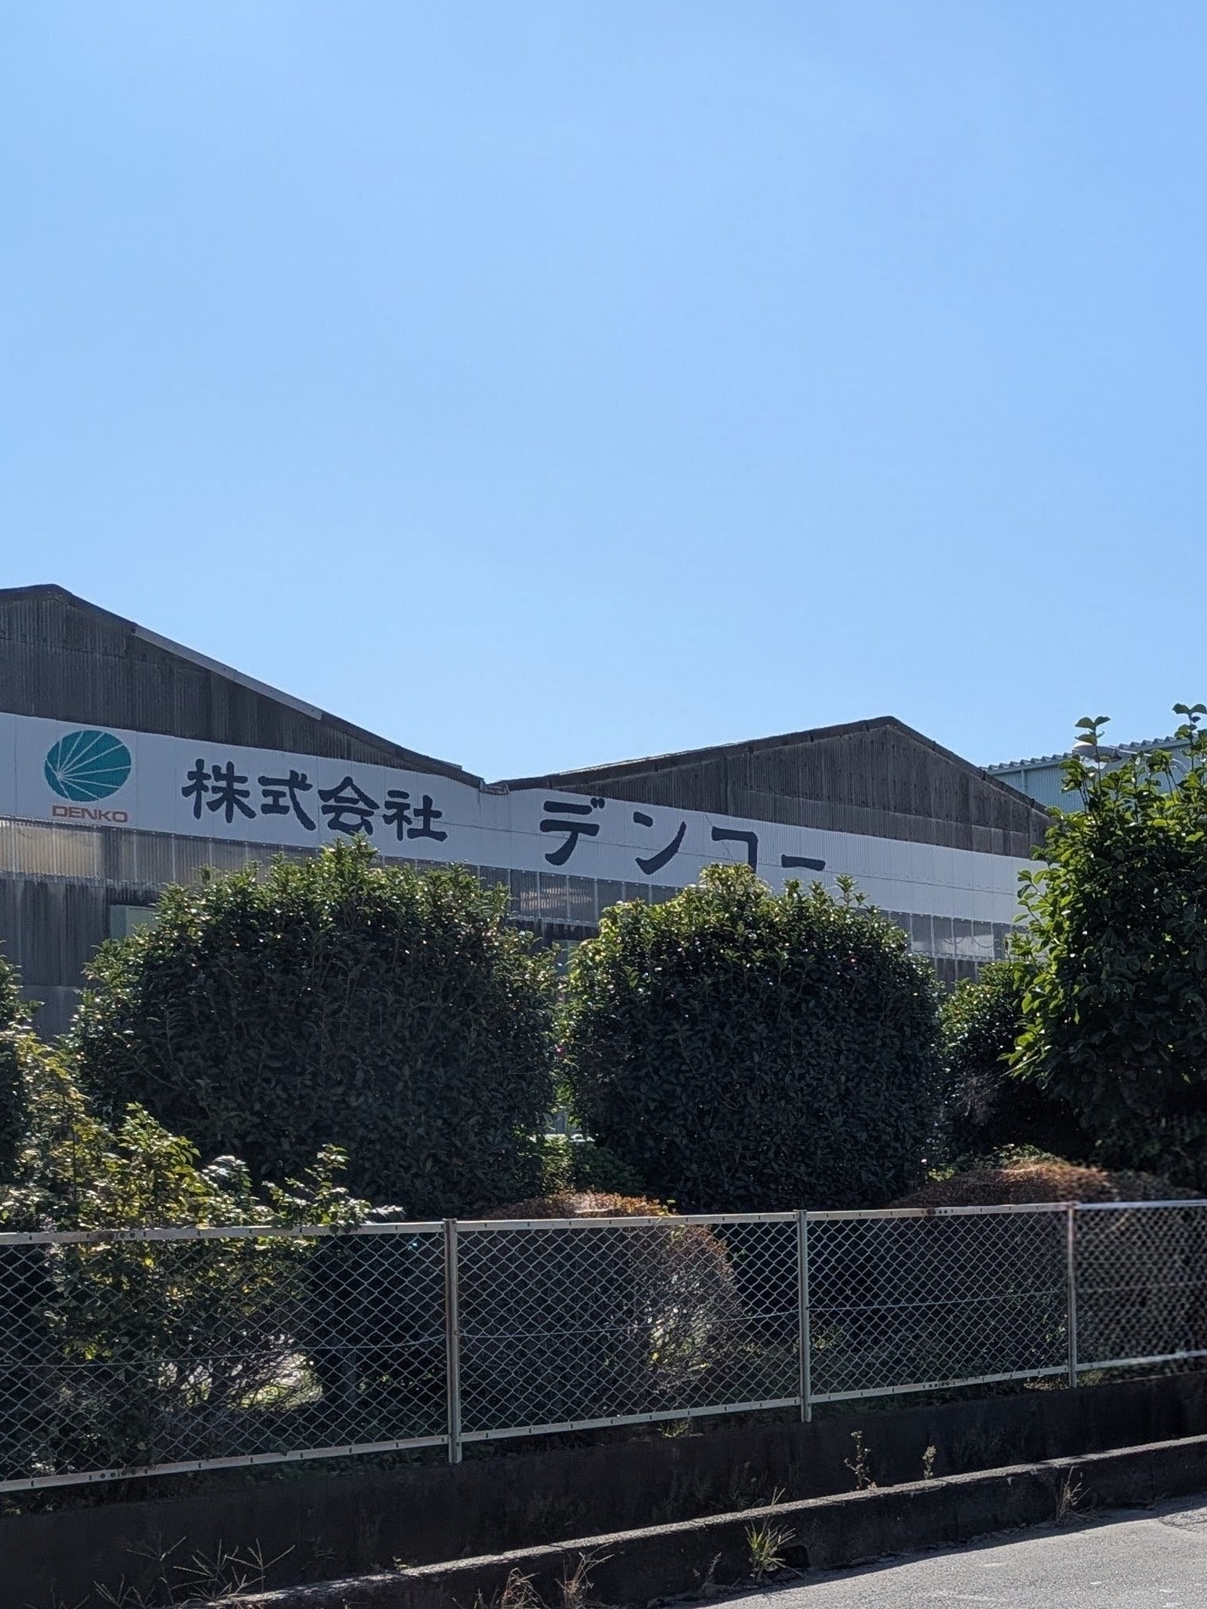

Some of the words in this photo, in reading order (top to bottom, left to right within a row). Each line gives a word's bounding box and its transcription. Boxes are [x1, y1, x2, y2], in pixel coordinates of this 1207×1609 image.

[52, 805, 129, 823] DENKO
[181, 758, 448, 842] 株式会社
[539, 797, 827, 876] デンコー
